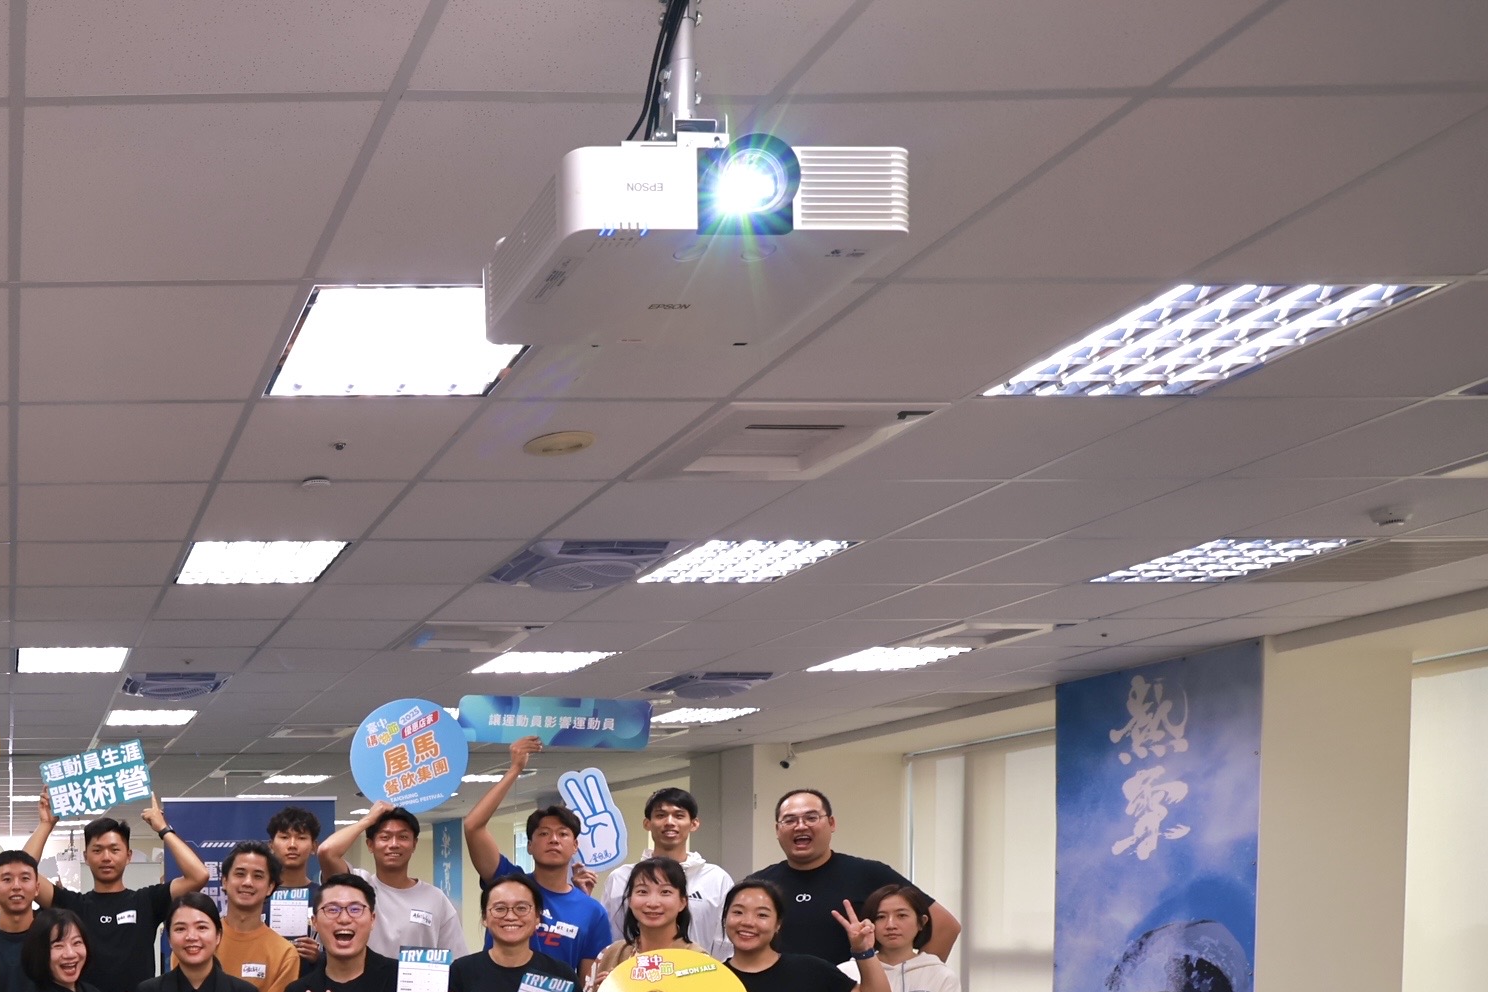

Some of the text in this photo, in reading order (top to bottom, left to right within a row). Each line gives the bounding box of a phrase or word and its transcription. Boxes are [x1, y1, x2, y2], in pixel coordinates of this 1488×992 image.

[626, 182, 664, 192] EPSON
[400, 708, 421, 725] 2025
[488, 713, 615, 732] 讓運動員影響運動員
[43, 741, 142, 782] 運動員生涯
[384, 731, 440, 777] 屋馬
[384, 757, 450, 797] 餐飲集團
[49, 765, 150, 816] 戰術營
[291, 888, 308, 899] OUT
[400, 949, 450, 962] TRY OUT
[699, 964, 716, 972] SALE
[525, 972, 575, 992] TRY OUT
